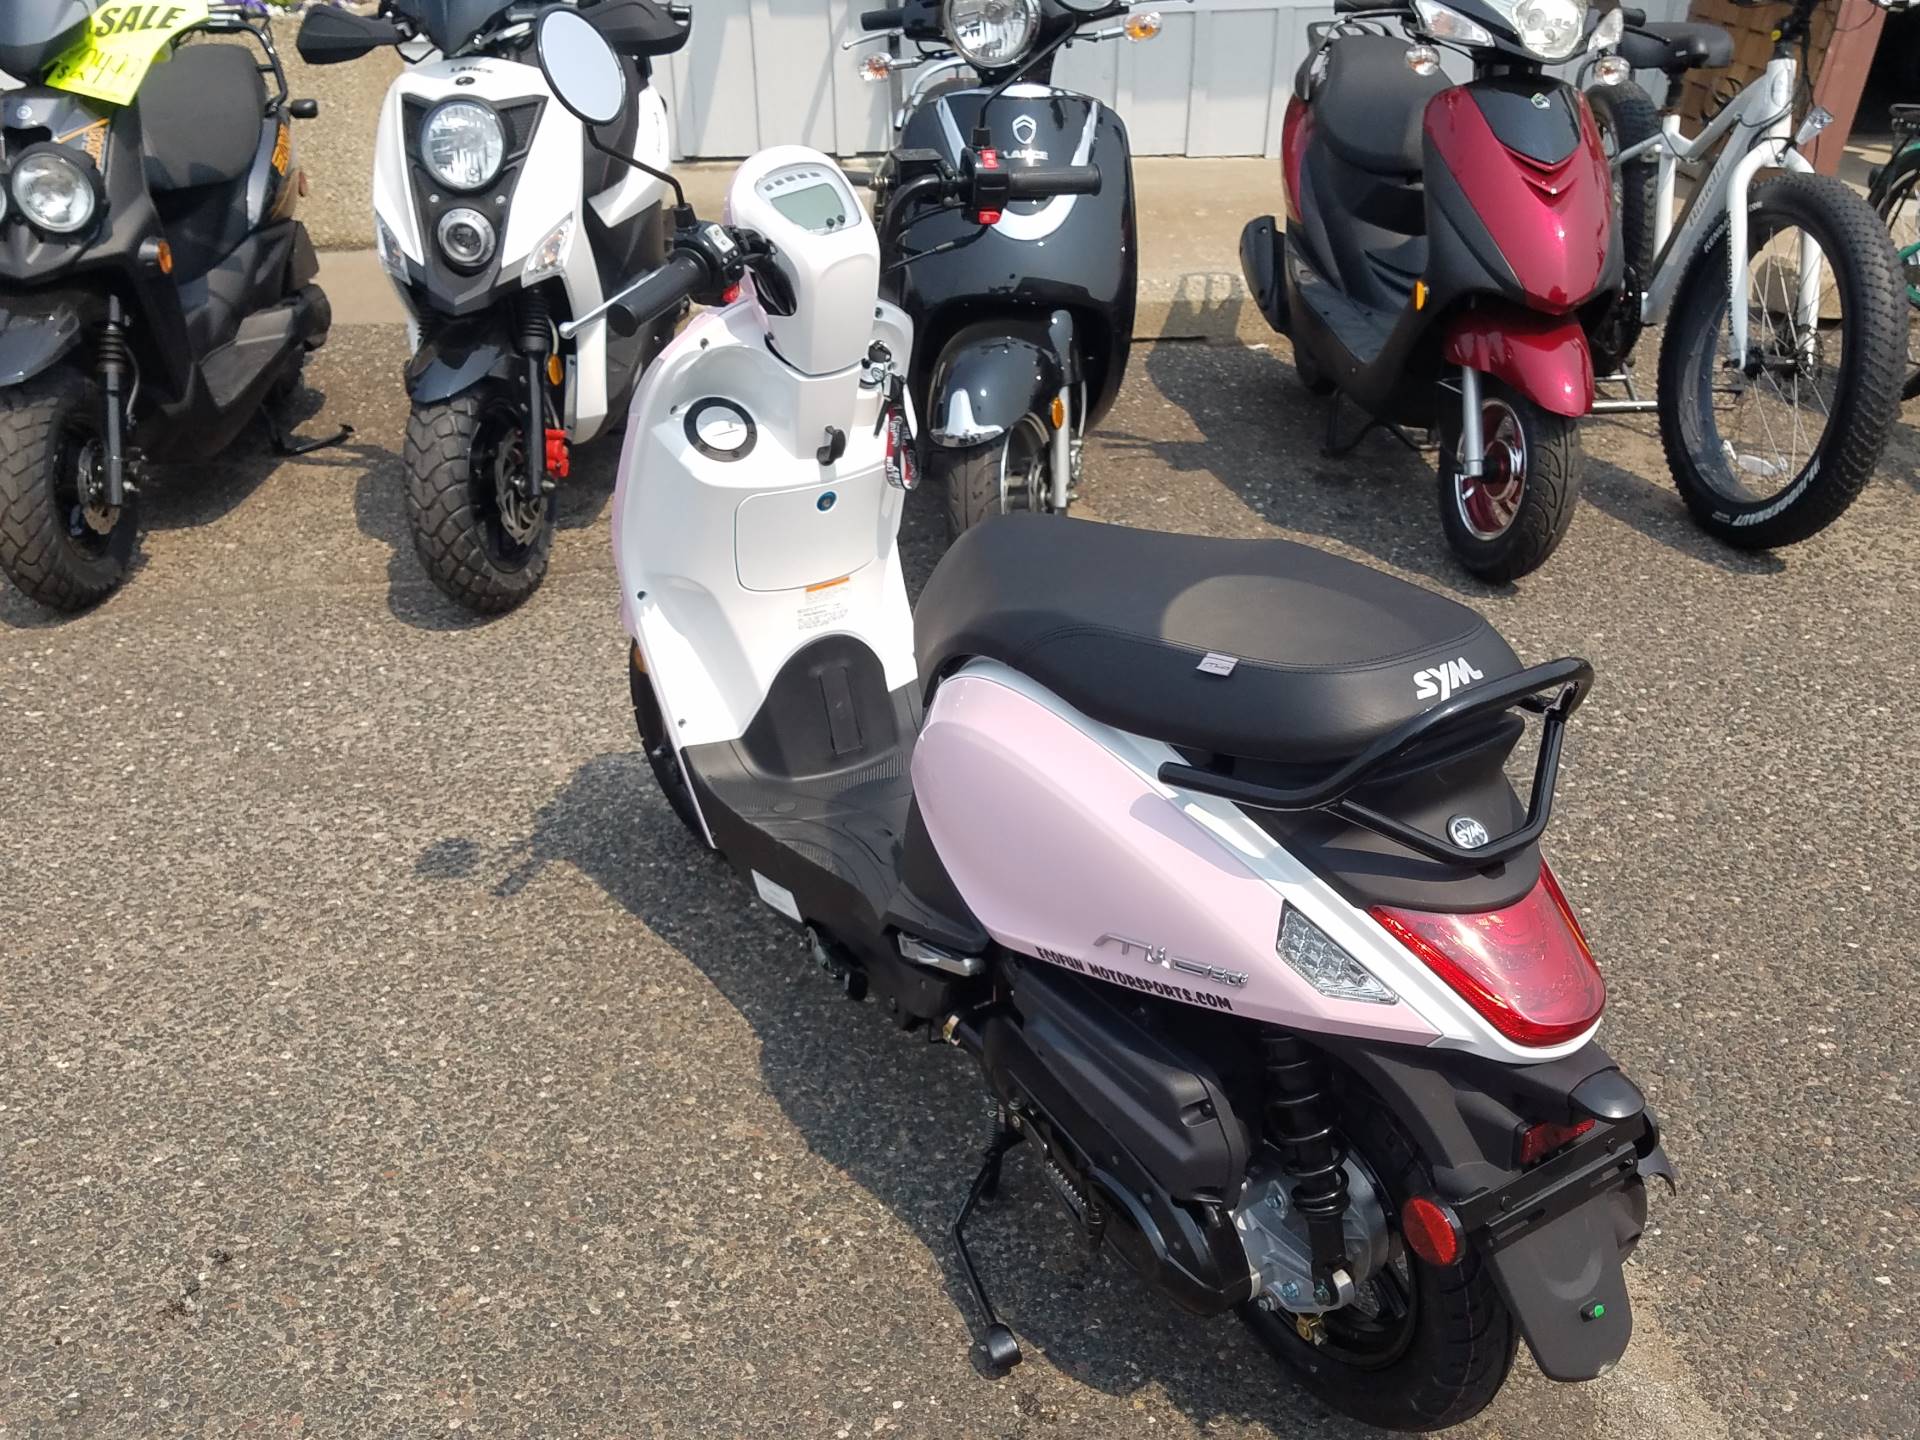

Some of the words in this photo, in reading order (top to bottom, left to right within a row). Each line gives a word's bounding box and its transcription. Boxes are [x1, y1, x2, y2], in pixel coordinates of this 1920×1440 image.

[95, 5, 187, 38] SALE
[1413, 656, 1485, 702] SYM
[1034, 945, 1086, 972] ECOFUN
[1087, 961, 1234, 1012] MOTORSPORTS.COM
